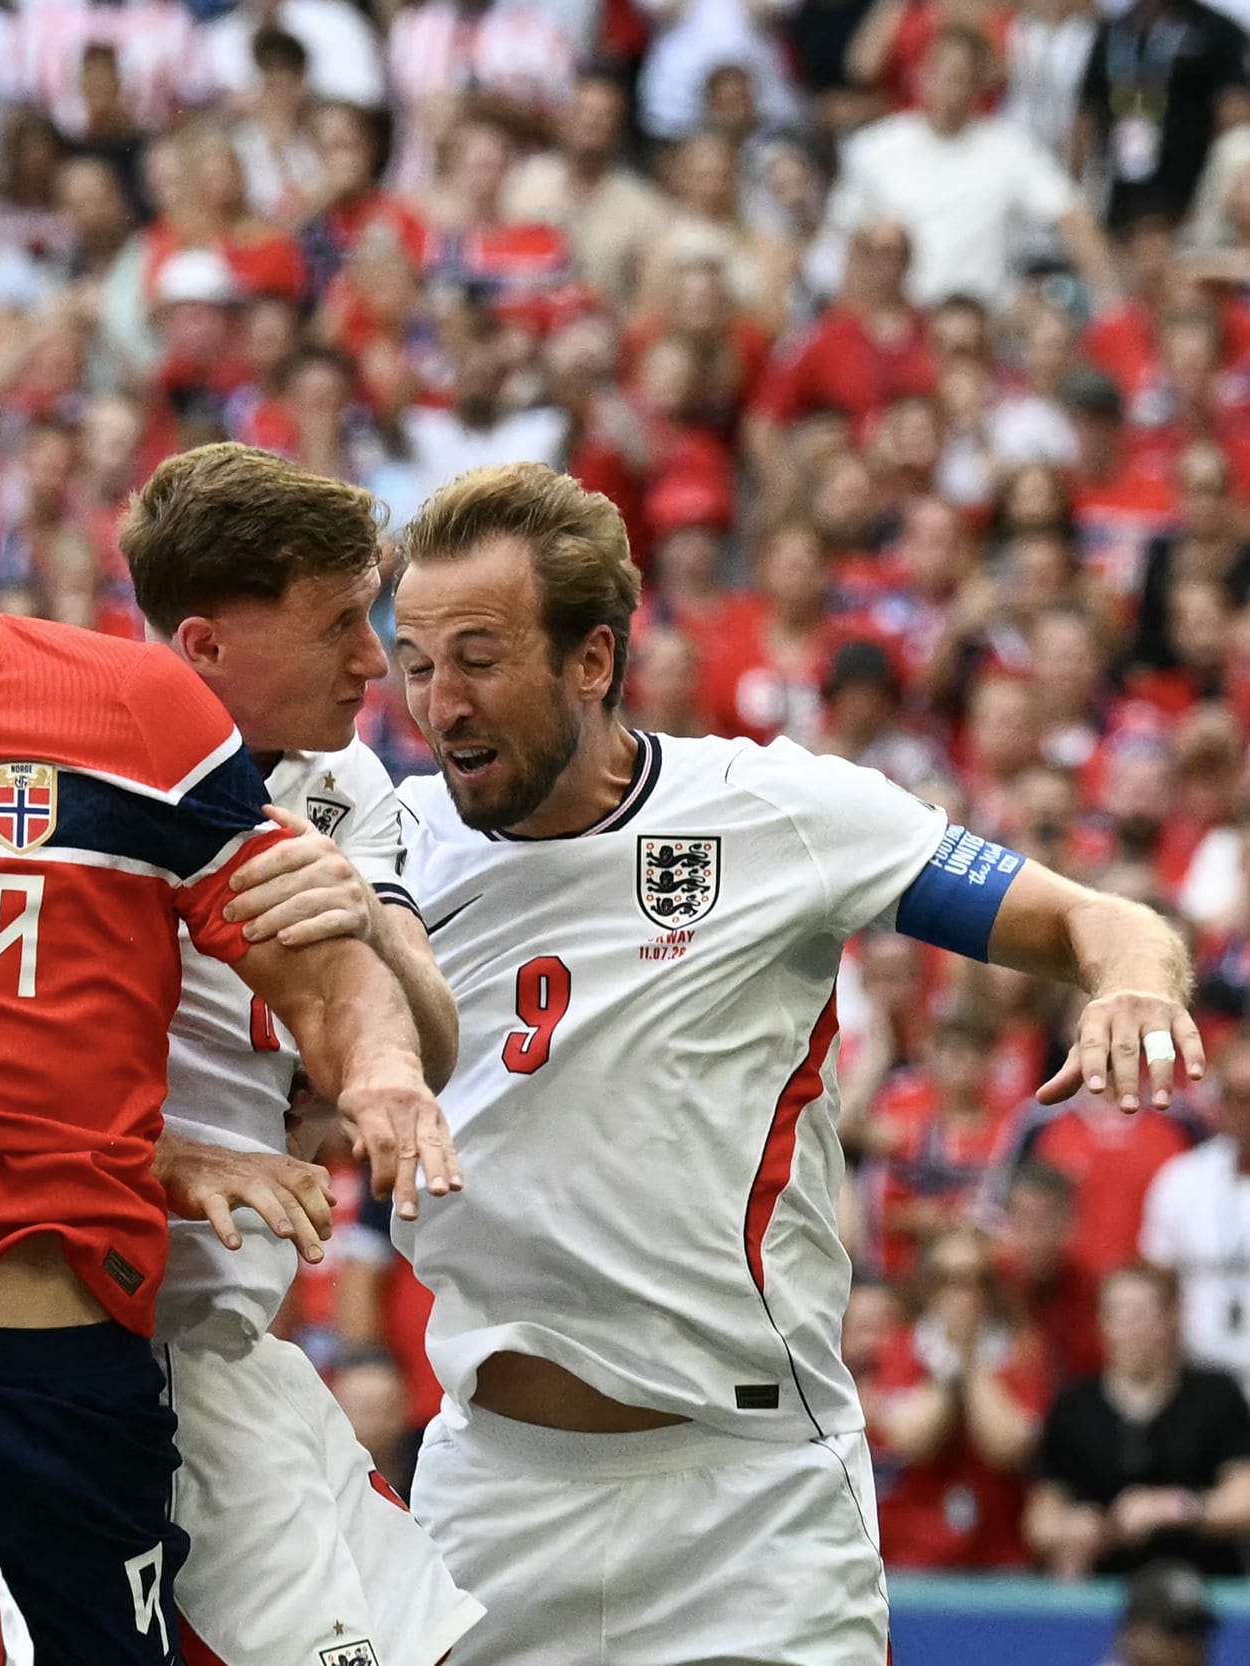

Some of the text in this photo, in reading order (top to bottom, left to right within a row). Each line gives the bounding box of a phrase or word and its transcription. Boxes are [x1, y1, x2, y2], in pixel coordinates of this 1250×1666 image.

[11, 765, 32, 773] NORGE
[502, 956, 571, 1075] 9
[124, 1541, 169, 1656] 9
